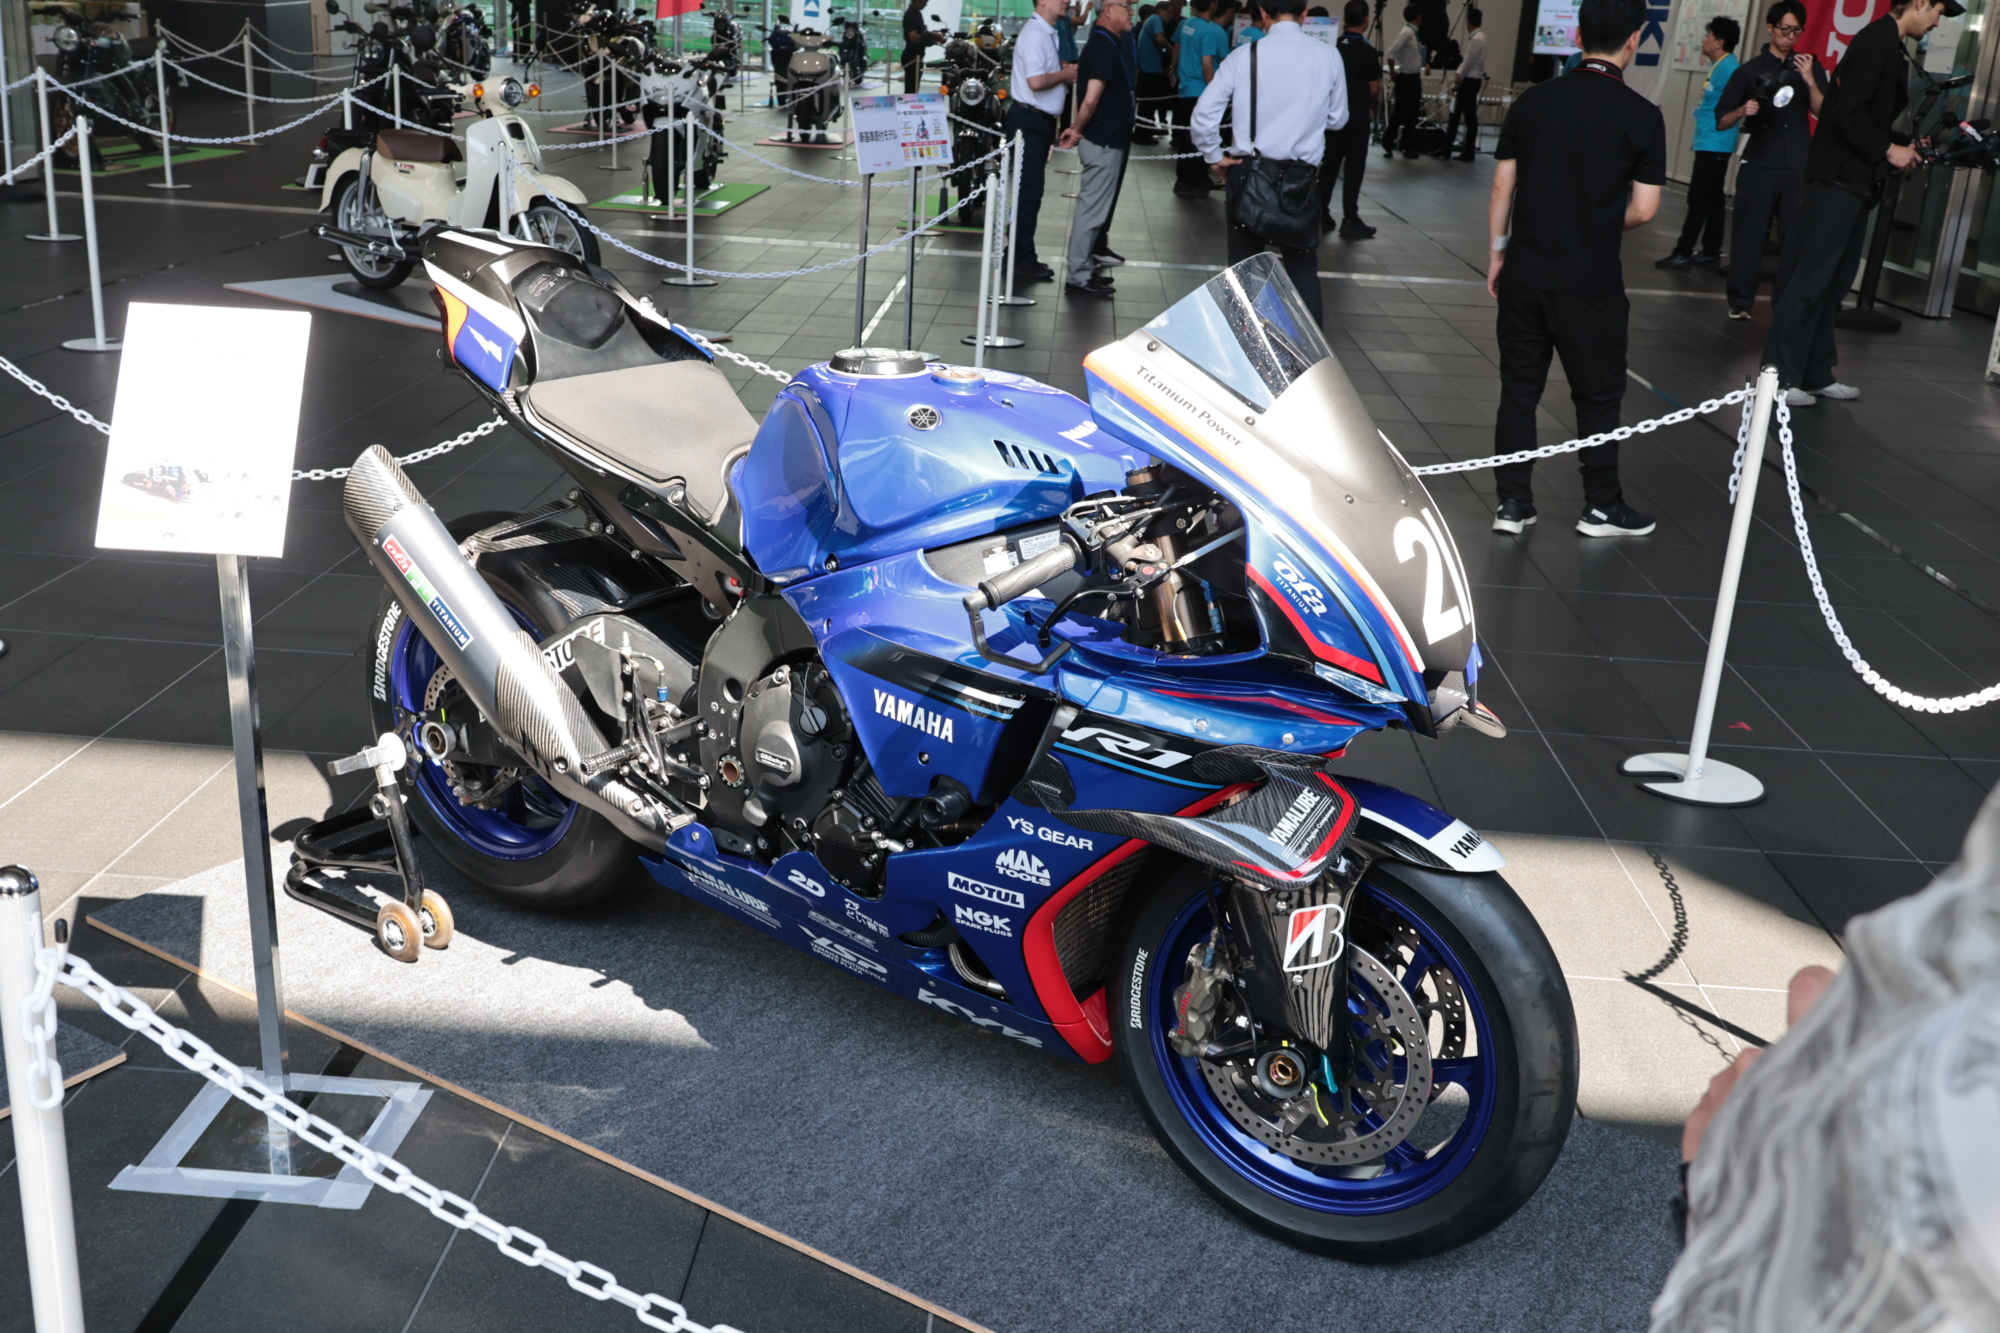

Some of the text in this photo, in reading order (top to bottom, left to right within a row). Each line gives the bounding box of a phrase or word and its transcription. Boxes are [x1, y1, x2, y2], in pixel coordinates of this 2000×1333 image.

[1136, 364, 1243, 446] Titanium Power
[1276, 575, 1311, 615] TITANIUM
[430, 599, 467, 645] TITANIUM
[373, 600, 402, 703] BRIDGESTONE
[873, 687, 954, 744] YAMAHA
[1006, 815, 1094, 851] Y'S GEAR
[1266, 786, 1321, 847] YAMALUBE
[787, 869, 826, 898] 2D
[995, 848, 1051, 879] MAC
[995, 865, 1051, 887] TOOLS
[952, 876, 1021, 906] MOTUL
[955, 903, 1012, 932] NGK
[955, 917, 1013, 938] SPARK PLUGS
[797, 923, 888, 974] YSP
[809, 941, 887, 983] YAMAHA MOTORCYCLE
[812, 947, 864, 975] SPORTS PLAZA
[1130, 947, 1149, 1030] BRIDGESTONE
[918, 987, 1043, 1049] KYB
